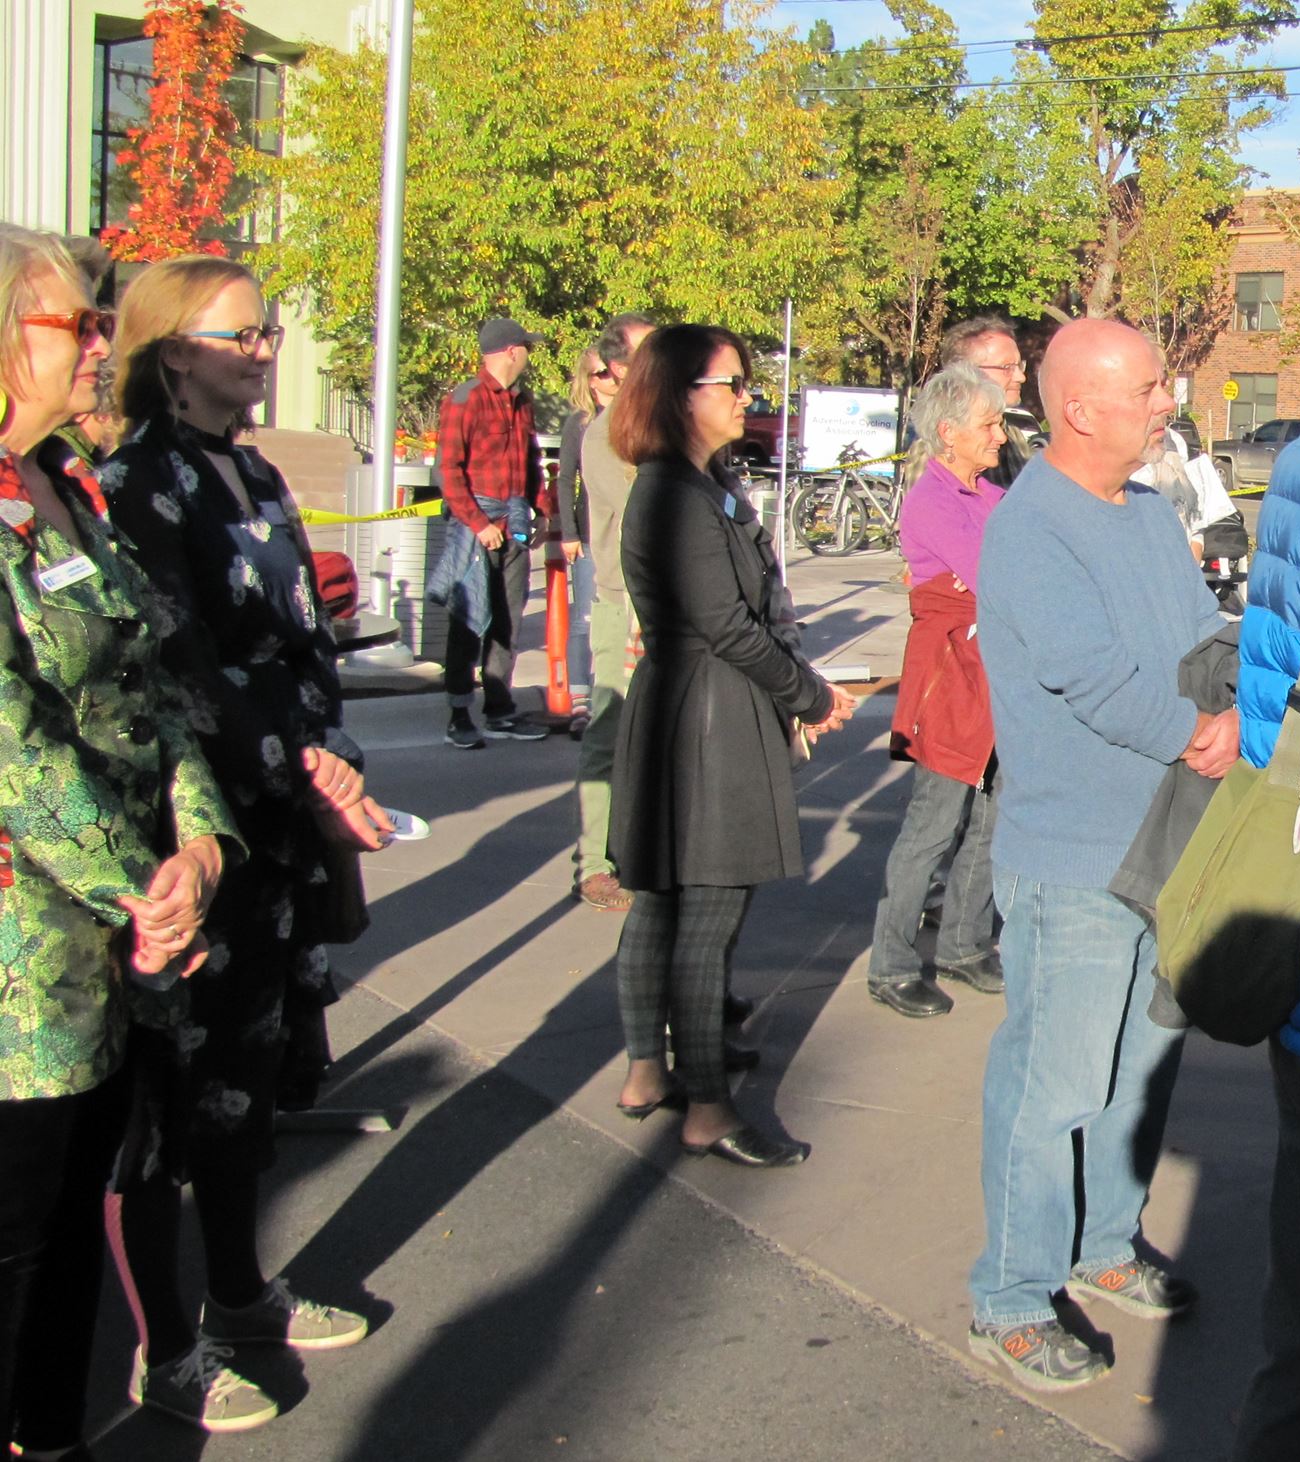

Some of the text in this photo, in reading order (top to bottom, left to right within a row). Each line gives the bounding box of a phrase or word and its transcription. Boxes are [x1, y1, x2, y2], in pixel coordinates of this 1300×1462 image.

[812, 416, 892, 429] Adventure Cycling
[825, 426, 877, 436] Association
[1098, 1269, 1129, 1292] N
[1004, 1333, 1031, 1358] N
